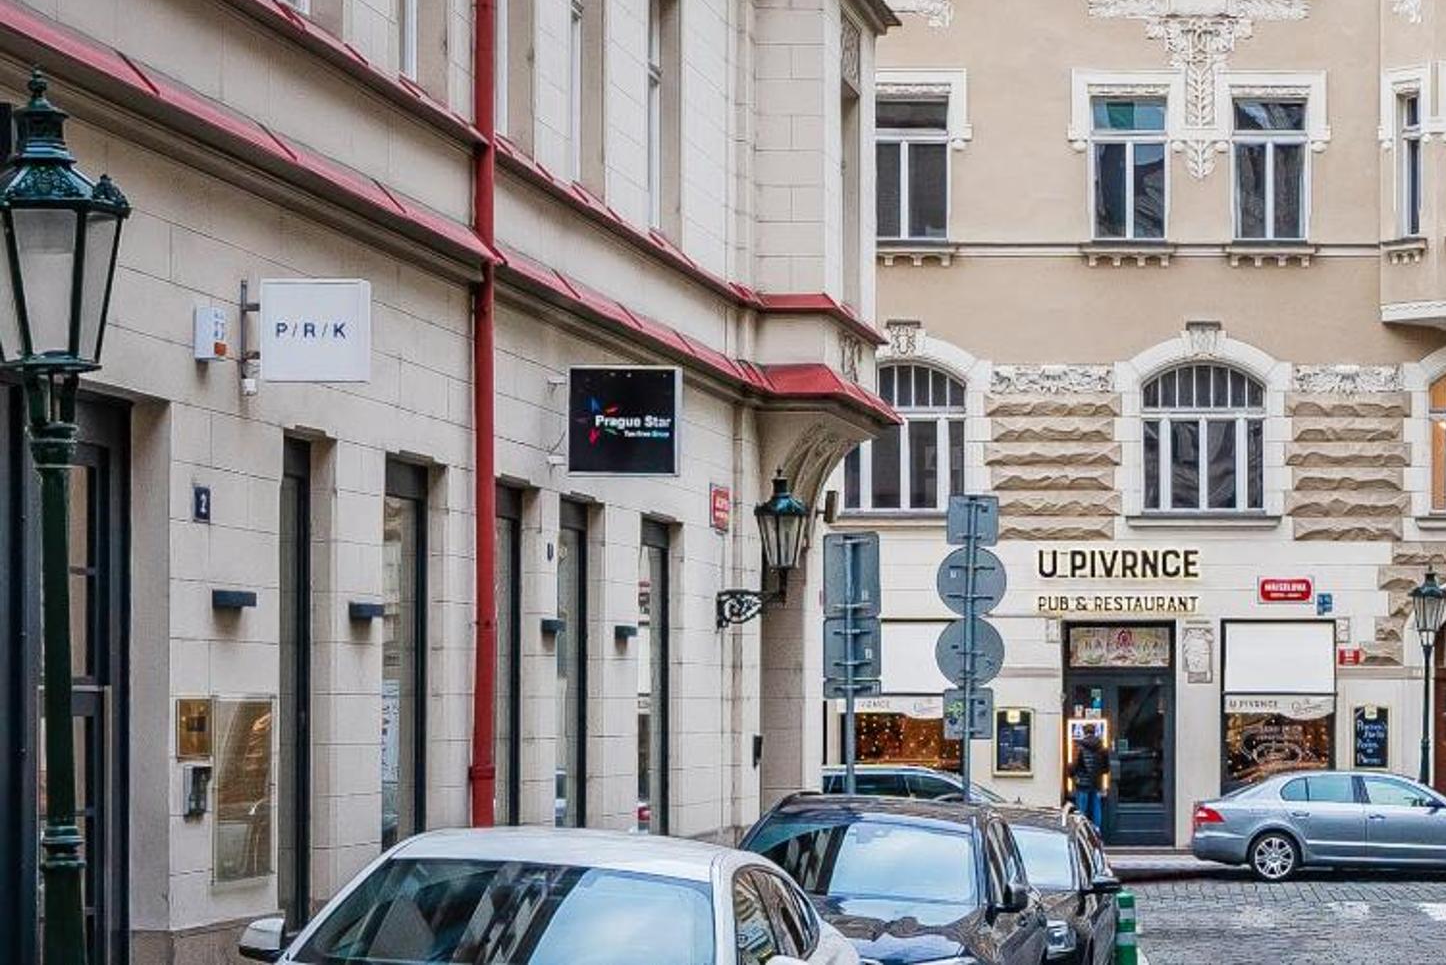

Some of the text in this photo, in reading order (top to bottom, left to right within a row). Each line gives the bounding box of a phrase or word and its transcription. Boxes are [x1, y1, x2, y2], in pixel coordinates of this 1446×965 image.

[595, 415, 671, 429] Prague Star
[1038, 550, 1199, 578] U PIVRNCE
[1038, 596, 1199, 612] PUB & RESTAURANT
